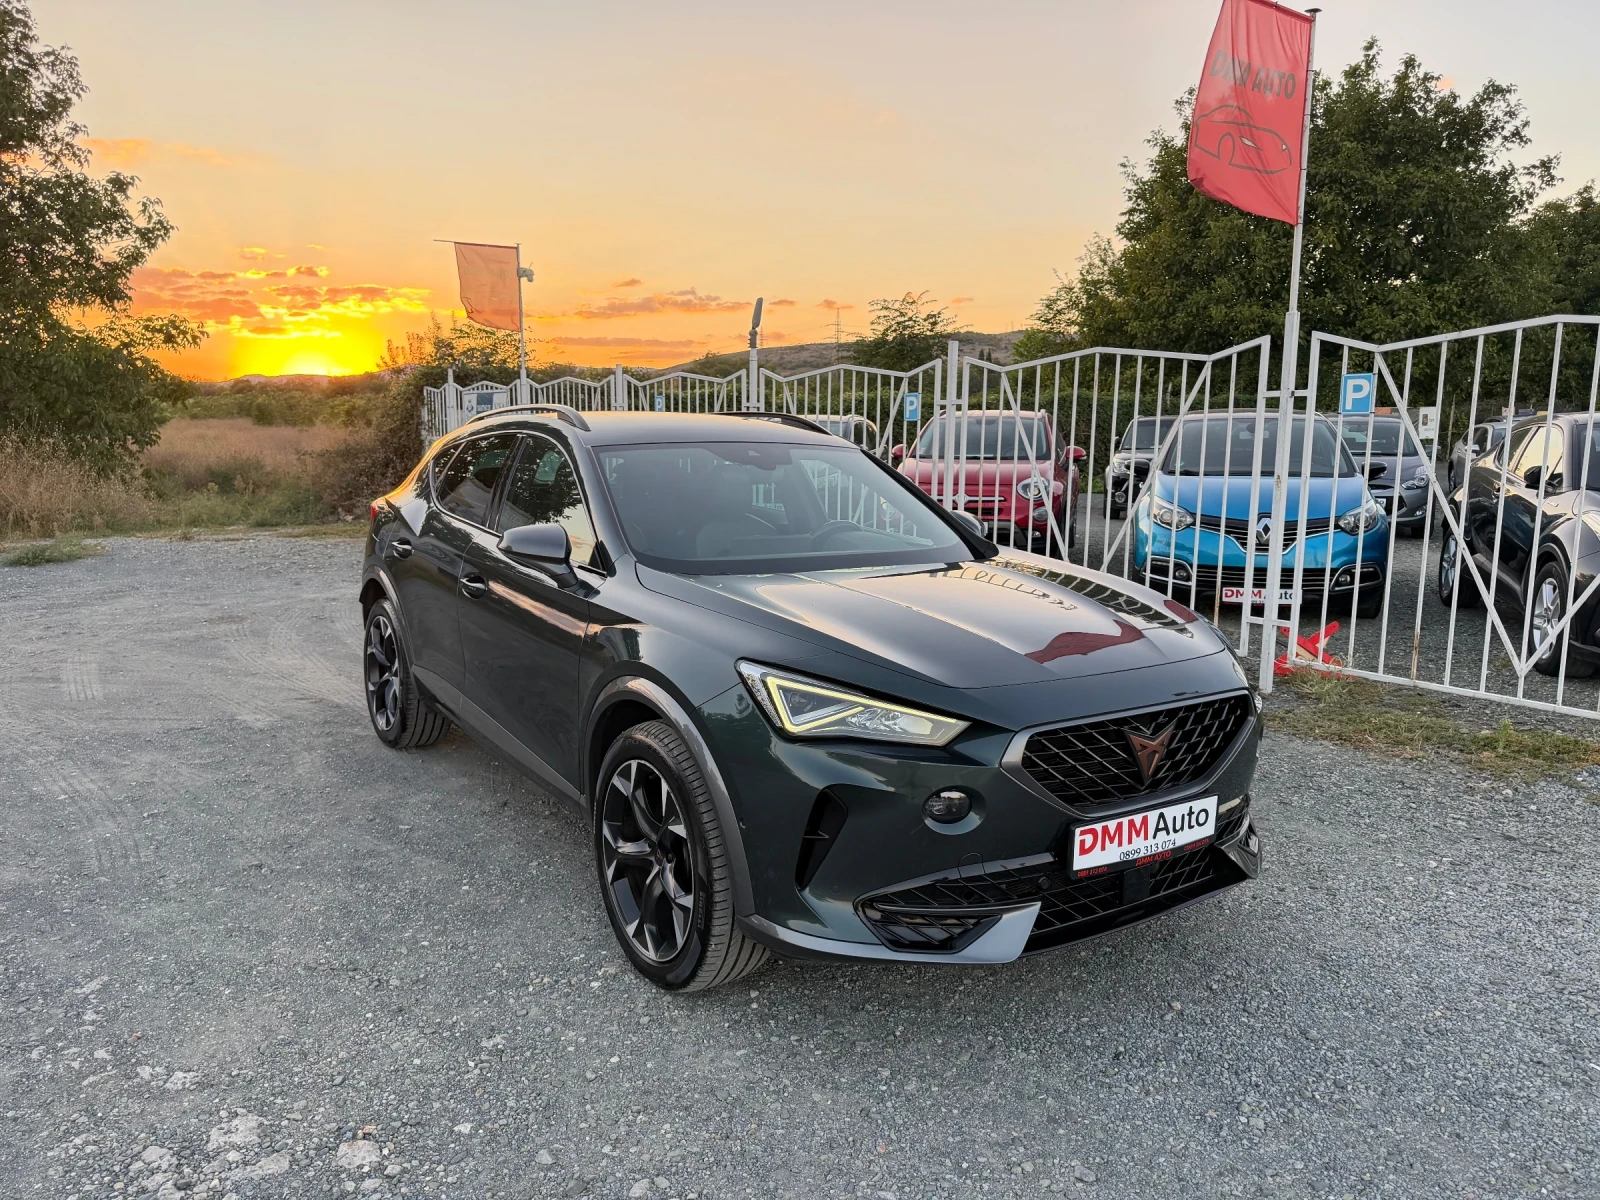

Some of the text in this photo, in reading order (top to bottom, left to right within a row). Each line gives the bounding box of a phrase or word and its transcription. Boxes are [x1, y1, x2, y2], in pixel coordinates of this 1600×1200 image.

[1251, 65, 1297, 99] AUTO
[905, 396, 917, 418] P
[1345, 379, 1370, 410] P
[1078, 805, 1209, 856] DMM Auto
[1119, 847, 1142, 861] 0899
[1143, 842, 1160, 855] 313
[1161, 838, 1176, 850] 074
